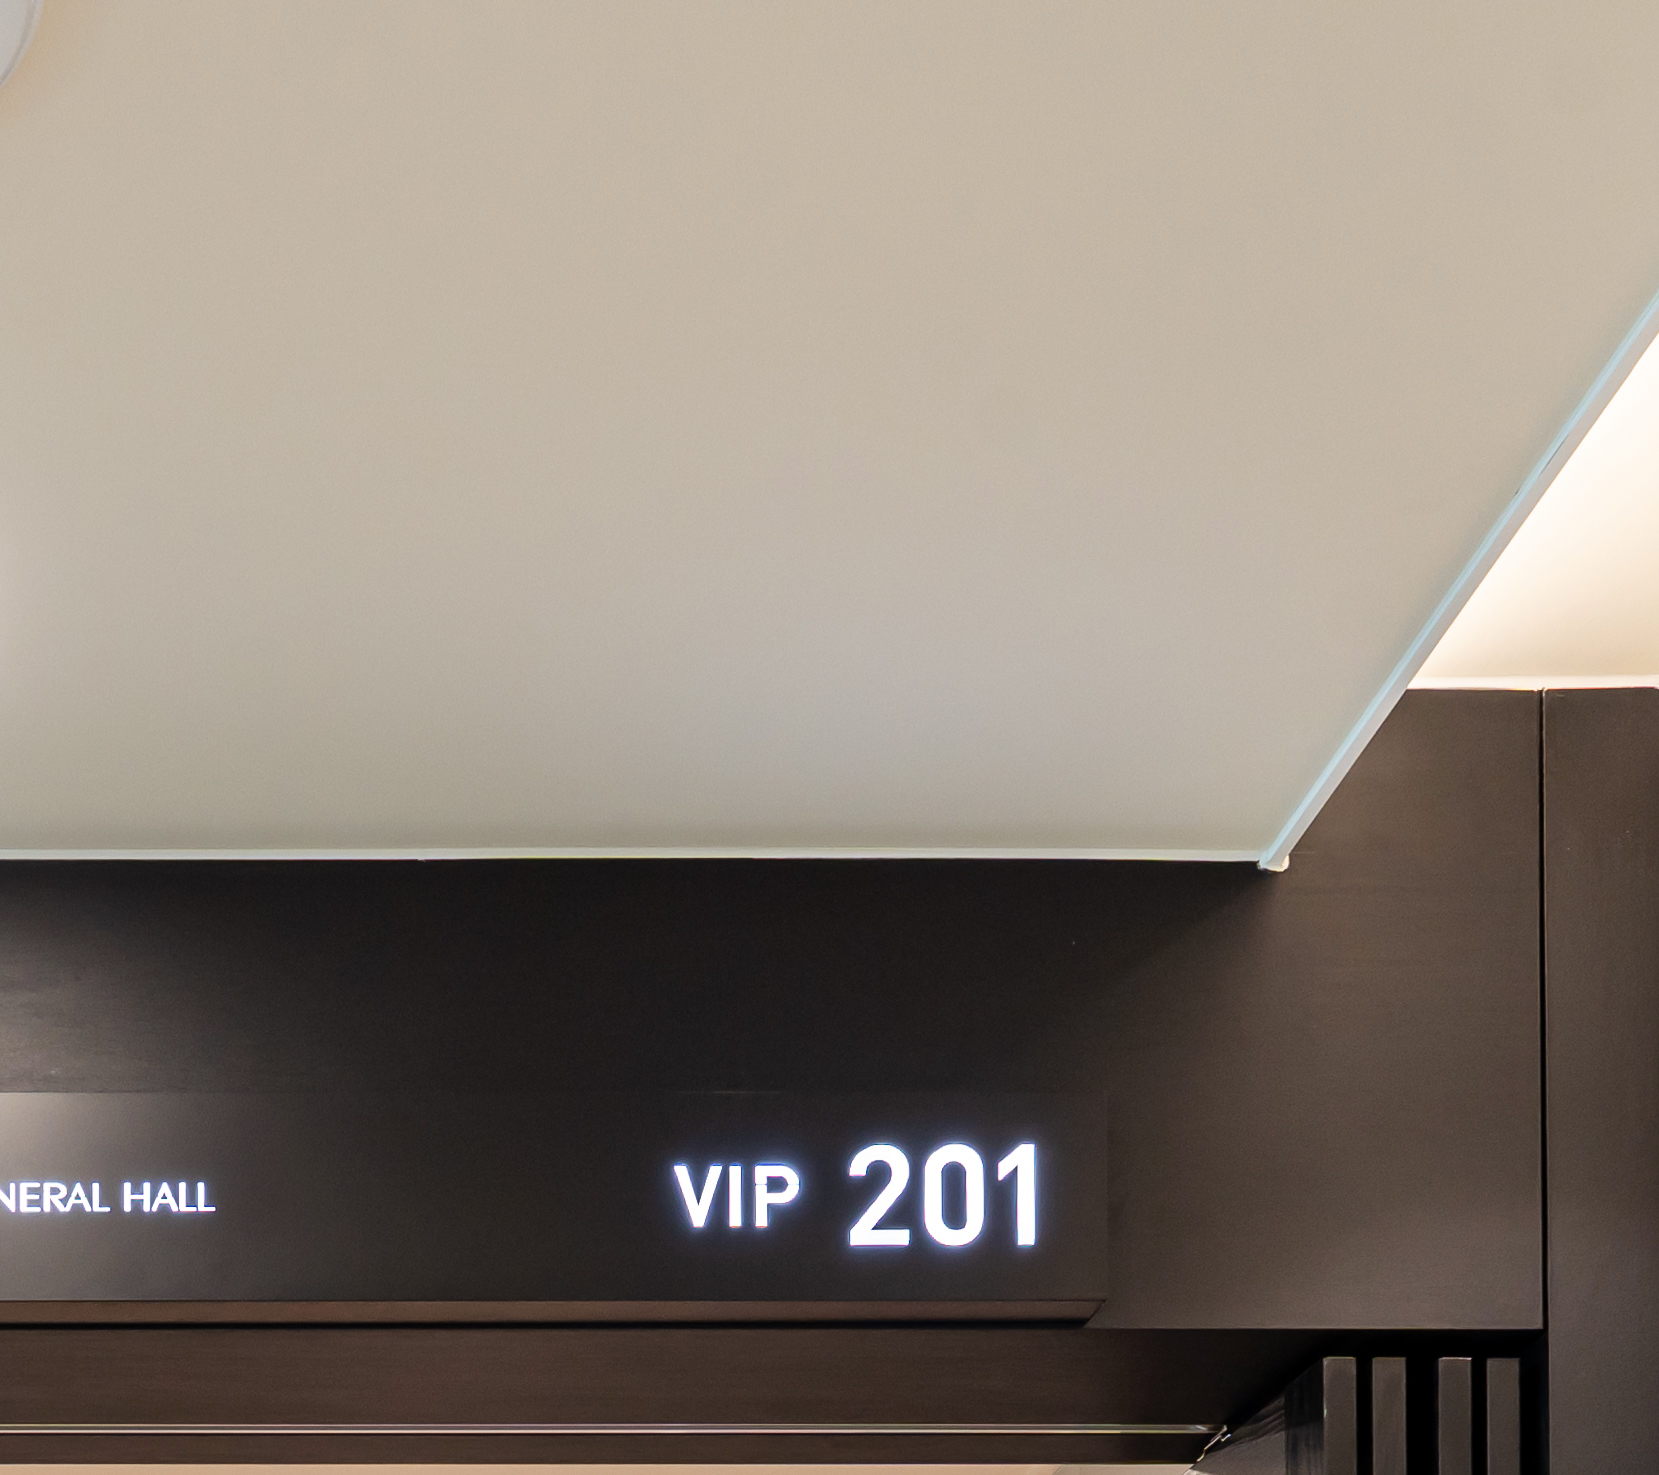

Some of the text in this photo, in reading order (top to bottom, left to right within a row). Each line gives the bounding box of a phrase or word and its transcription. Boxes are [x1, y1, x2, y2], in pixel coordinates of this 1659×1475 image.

[122, 1180, 216, 1214] HALL
[673, 1142, 1037, 1247] VIP 201
